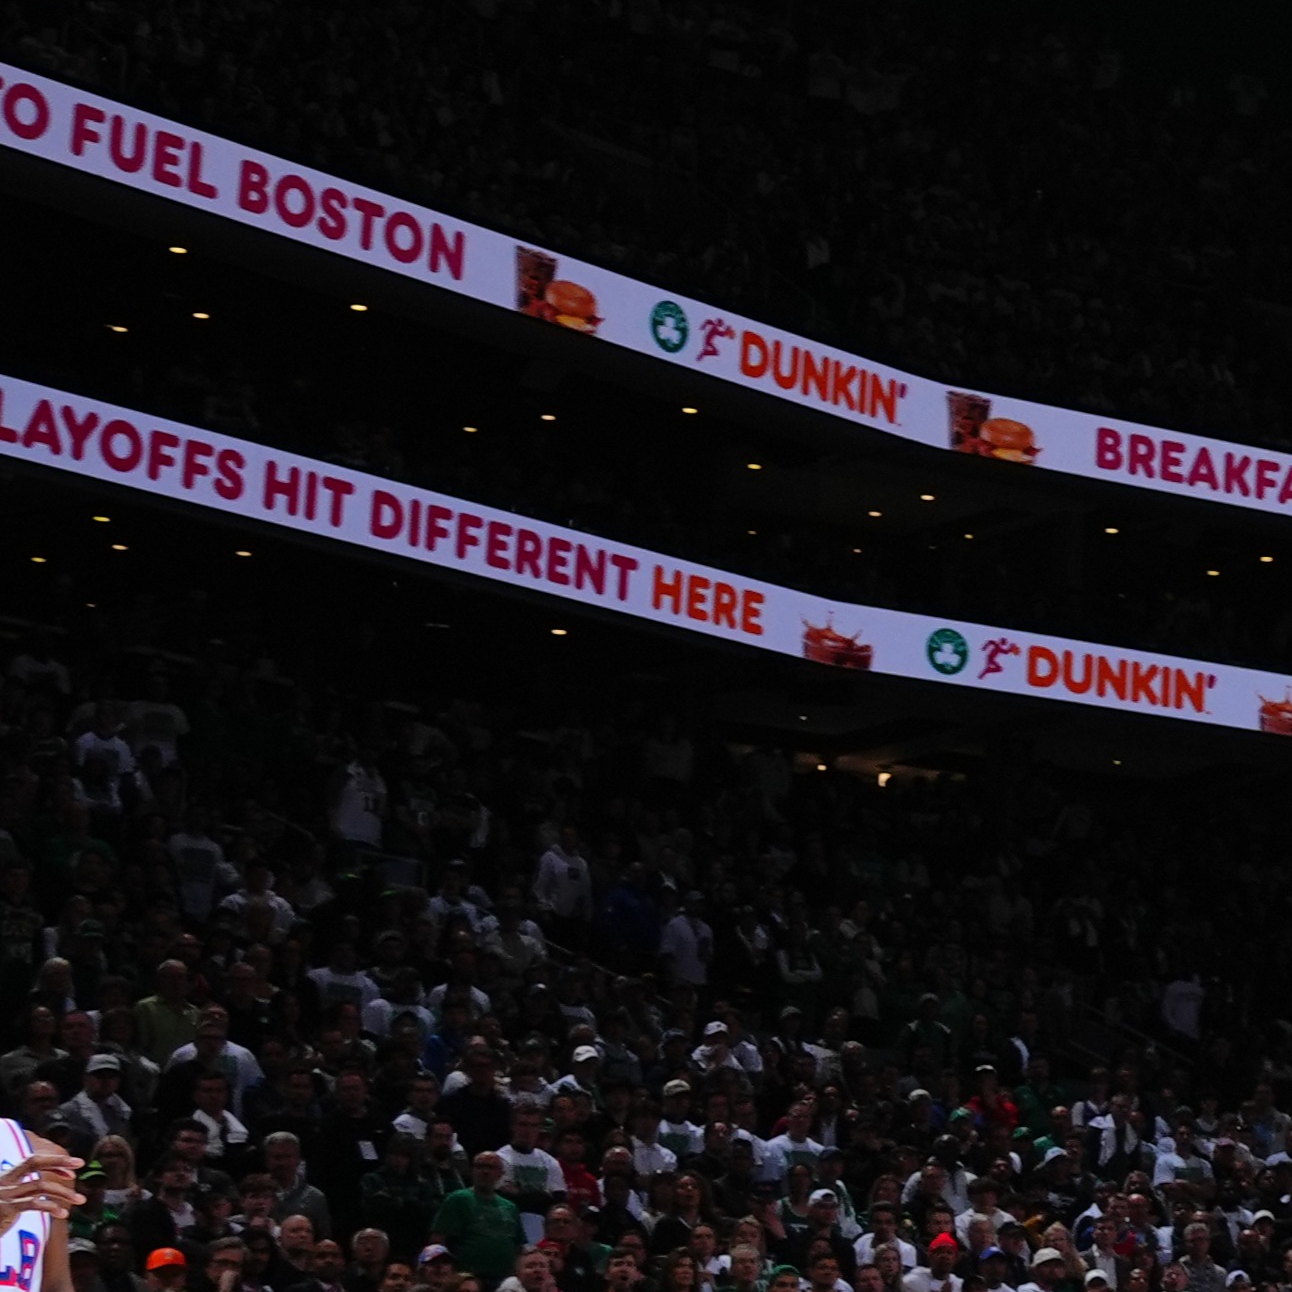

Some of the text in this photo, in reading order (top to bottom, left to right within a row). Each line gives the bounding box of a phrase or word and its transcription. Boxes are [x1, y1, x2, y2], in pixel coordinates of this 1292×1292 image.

[0, 75, 466, 281] O FUEL BOSTON
[263, 459, 356, 528] HIT
[369, 489, 638, 602] DIFFERENT
[651, 564, 765, 636] HERE
